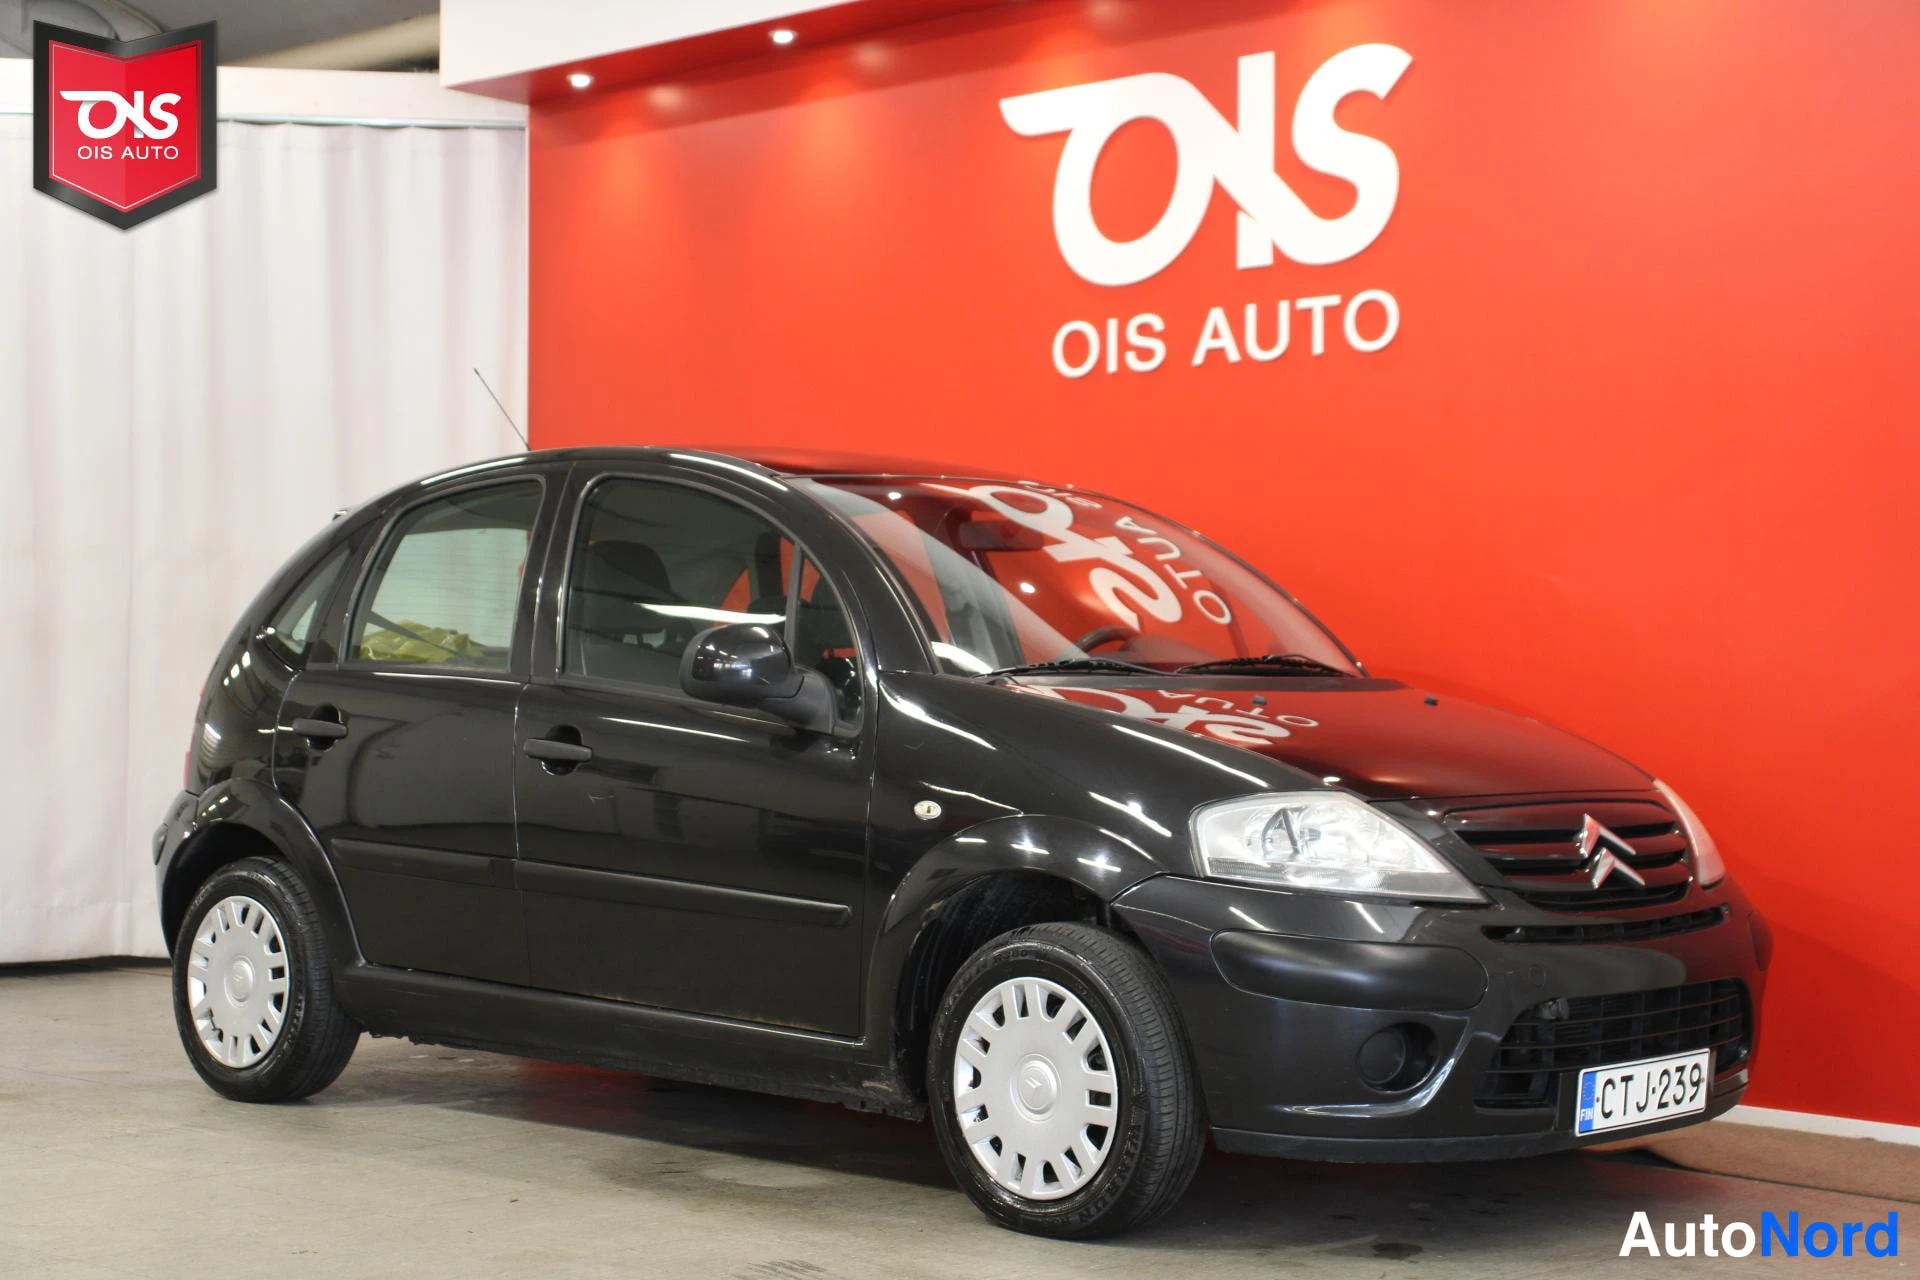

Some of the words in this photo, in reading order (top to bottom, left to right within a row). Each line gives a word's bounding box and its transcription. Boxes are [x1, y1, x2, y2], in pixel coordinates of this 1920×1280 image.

[999, 43, 1413, 287] OIS
[1052, 313, 1167, 378] OIS
[1191, 289, 1400, 366] AUTO
[1580, 1108, 1595, 1122] FIN
[1601, 1063, 1702, 1119] CTJ-239
